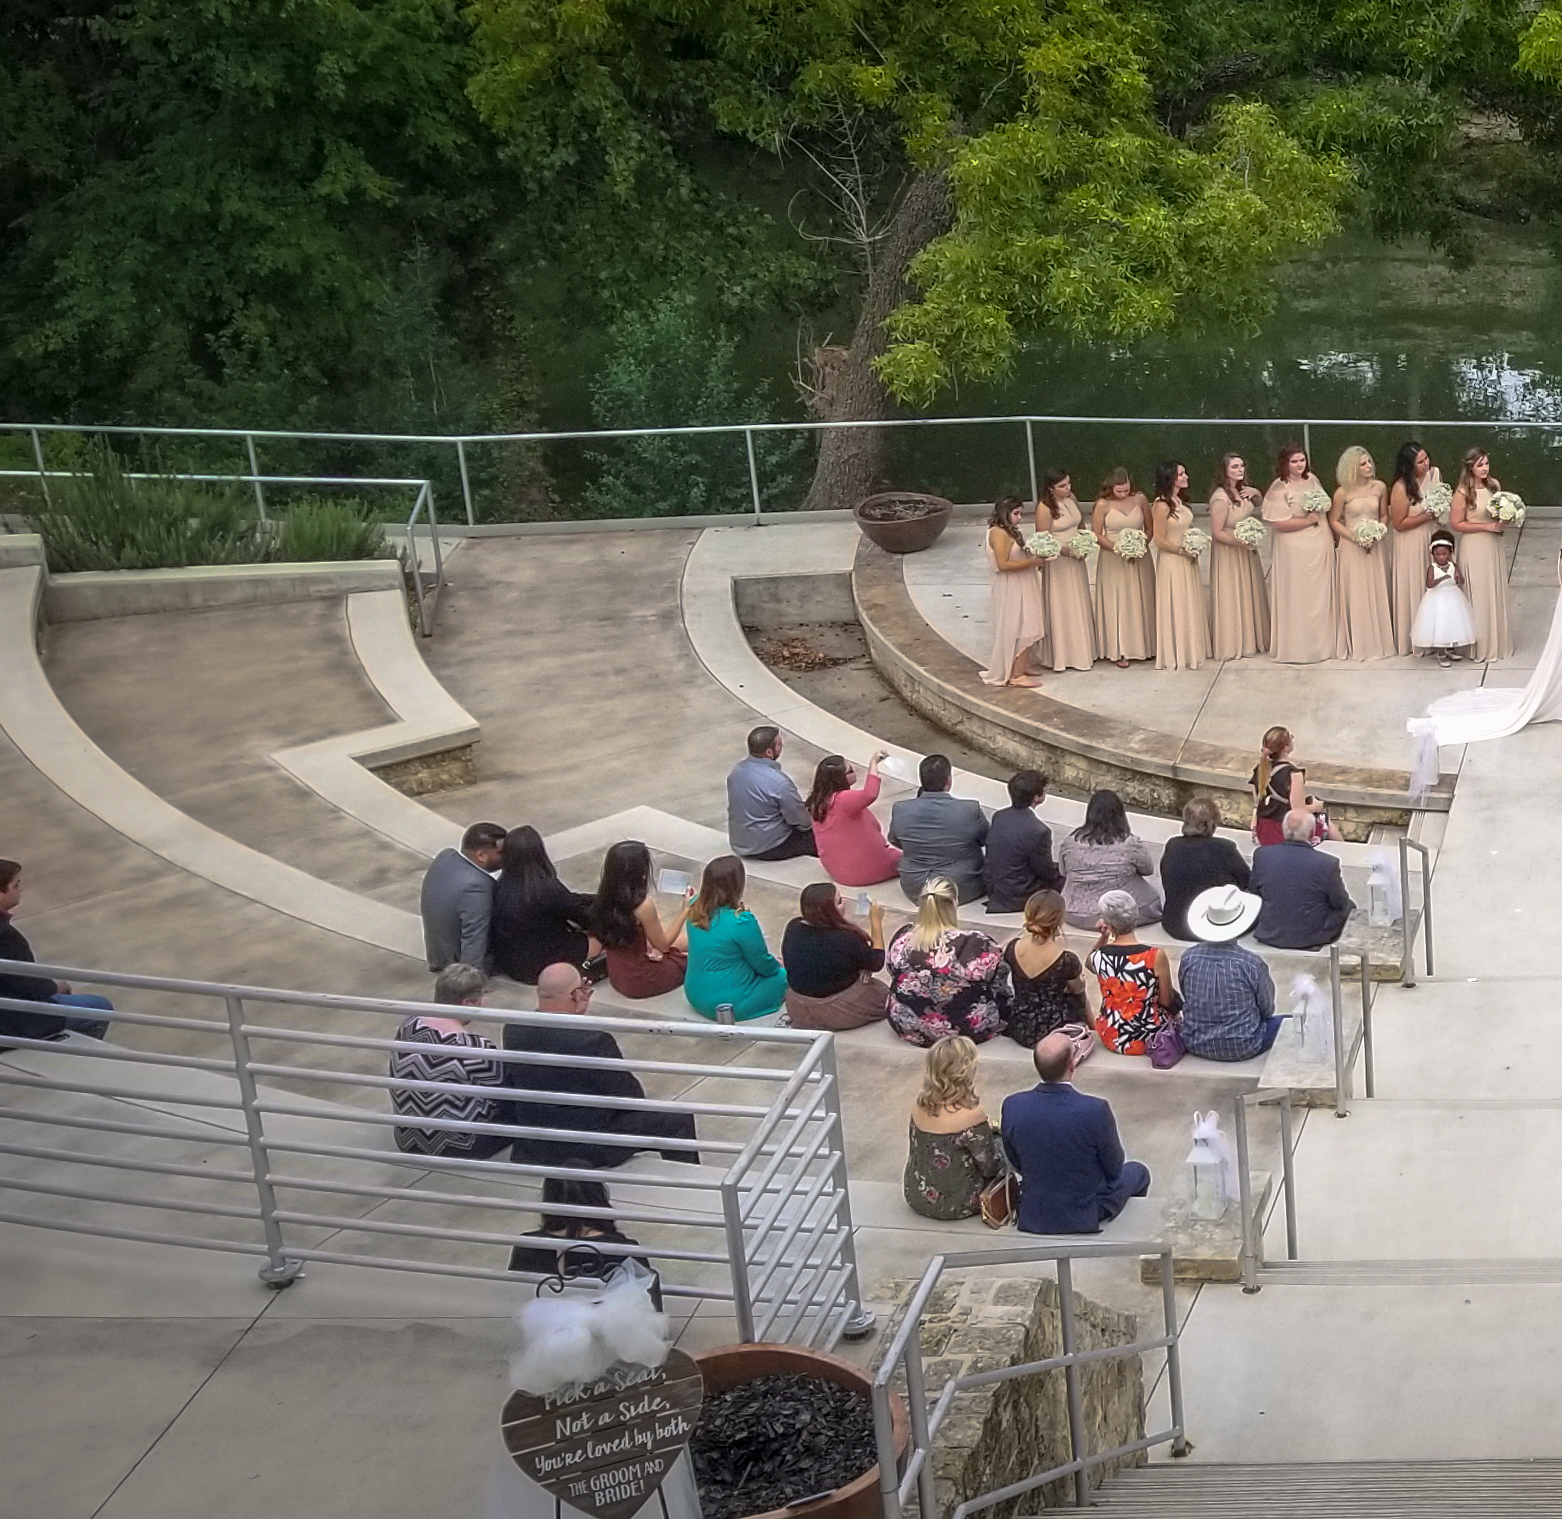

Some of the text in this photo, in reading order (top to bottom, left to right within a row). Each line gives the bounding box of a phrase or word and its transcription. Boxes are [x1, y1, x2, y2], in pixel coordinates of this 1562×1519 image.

[544, 1368, 667, 1411] Pick a Seat,
[556, 1396, 670, 1439] Not a Side,
[535, 1415, 691, 1477] You're loved by both
[567, 1459, 664, 1497] THE GROOM AND
[595, 1479, 646, 1507] BRIDE!
